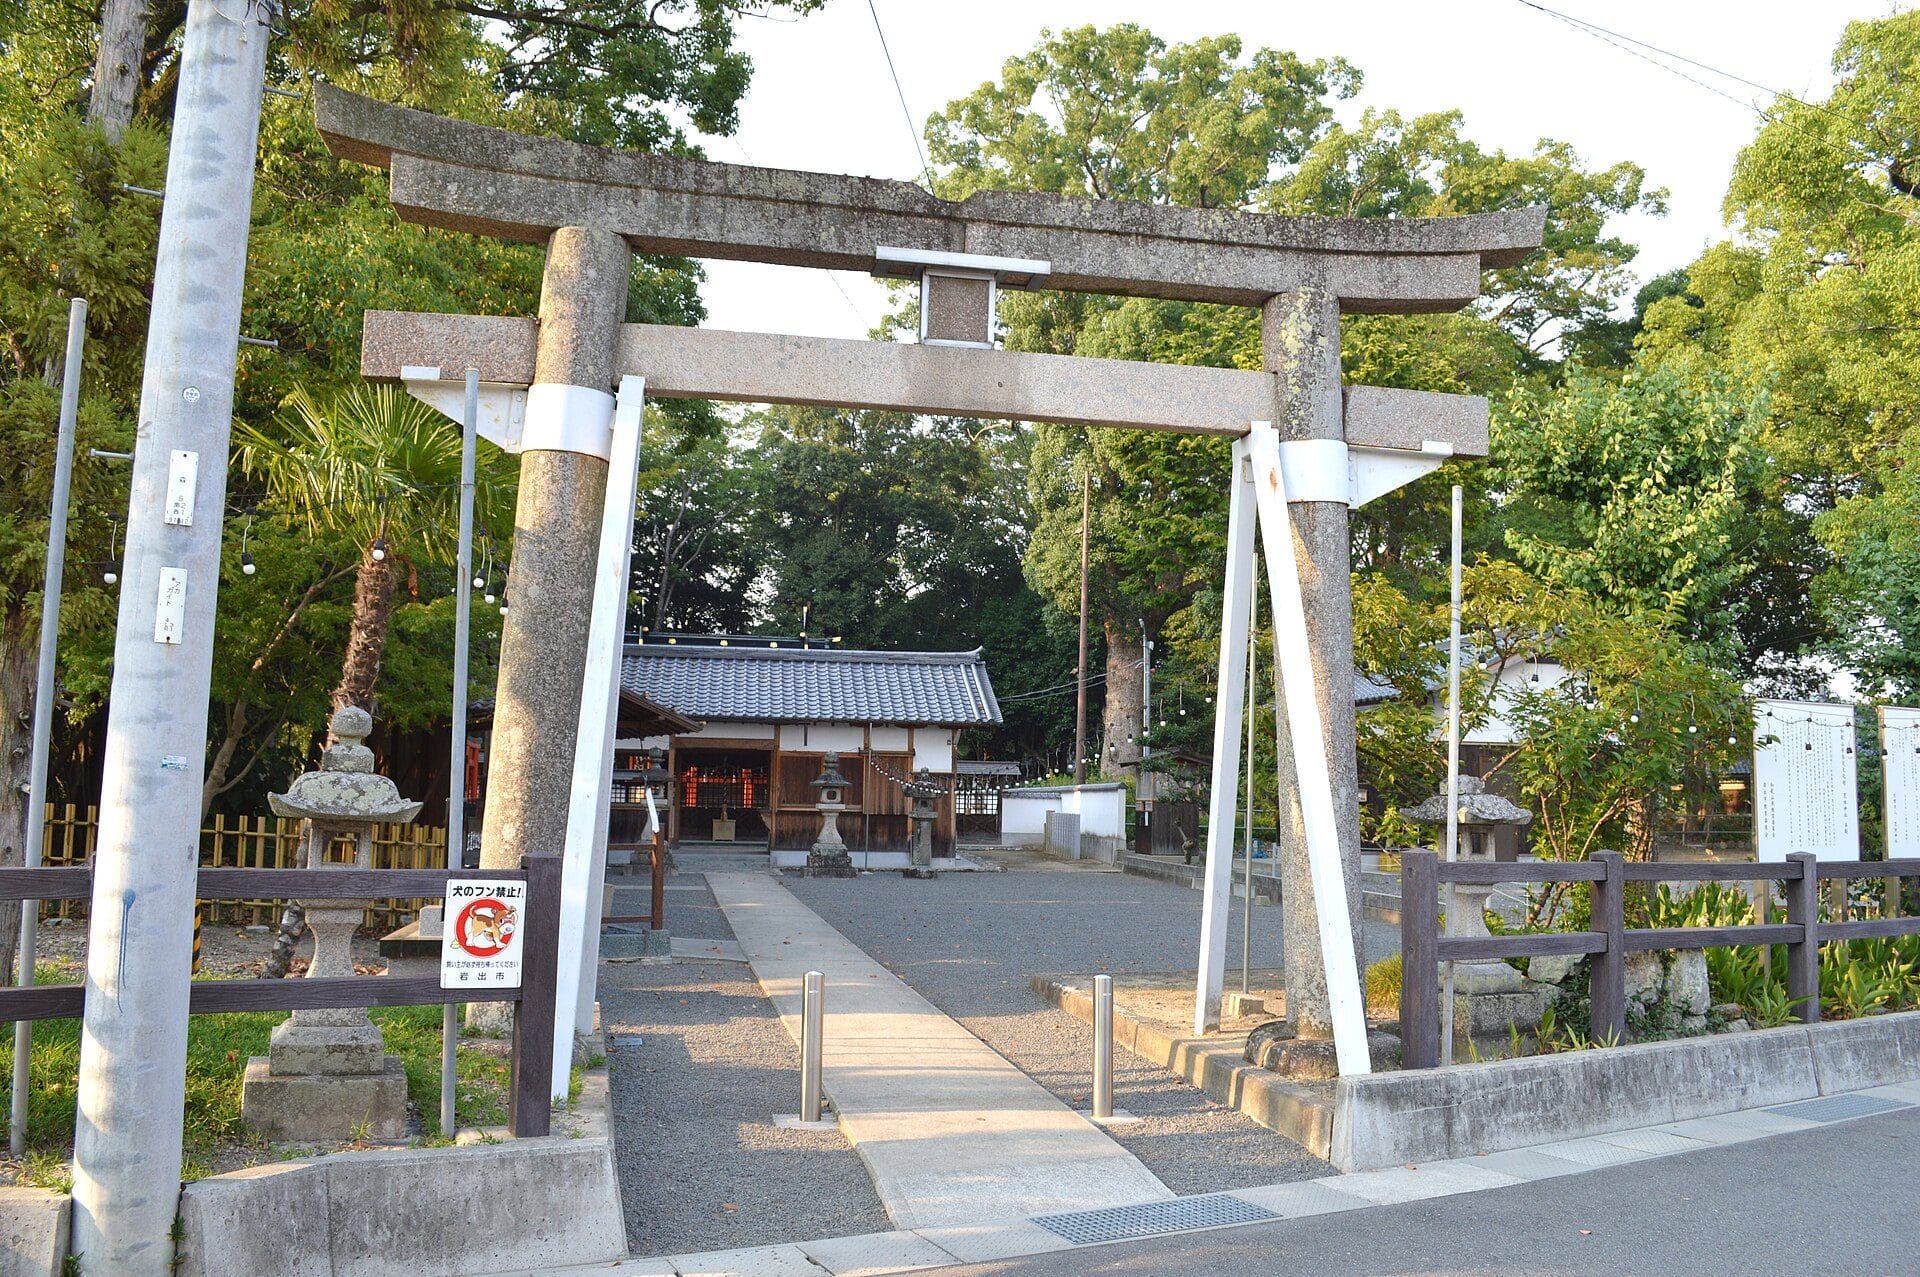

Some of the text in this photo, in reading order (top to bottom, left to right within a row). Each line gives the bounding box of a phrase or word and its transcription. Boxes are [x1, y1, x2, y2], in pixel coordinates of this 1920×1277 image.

[453, 885, 522, 898] 犬のフン禁止!
[446, 960, 519, 969] 飼い主が必ず持ち帰ってください
[459, 971, 505, 981] 岩出市
